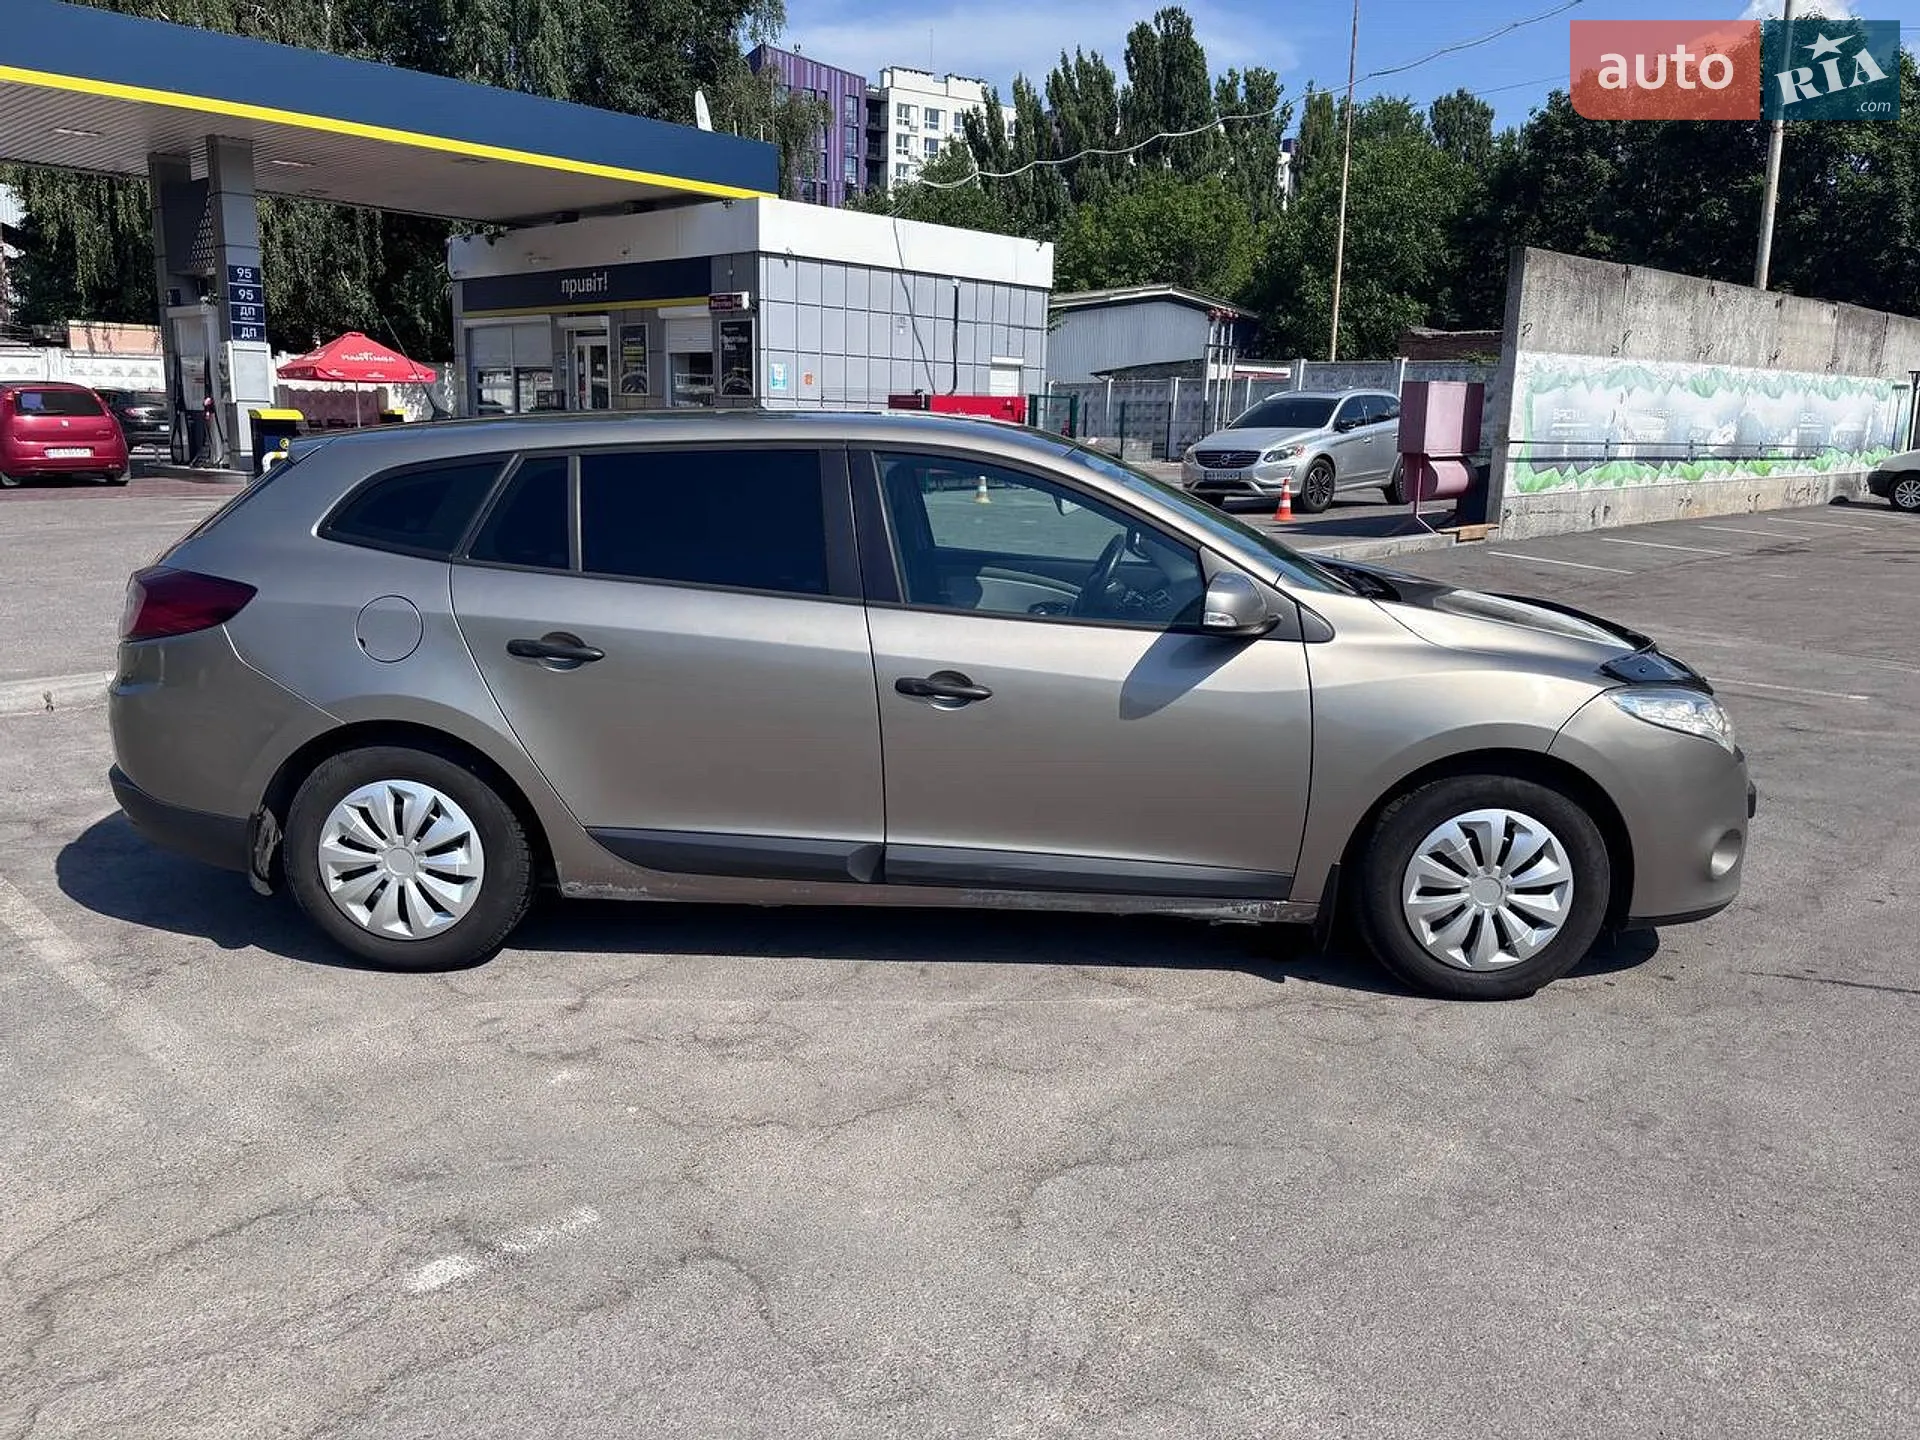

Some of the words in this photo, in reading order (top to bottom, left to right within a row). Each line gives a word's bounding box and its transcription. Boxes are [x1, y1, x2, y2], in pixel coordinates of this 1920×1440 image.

[236, 267, 252, 279] 95
[561, 271, 608, 300] привіт!
[238, 289, 254, 301] 95
[239, 306, 255, 317] ДП
[241, 327, 257, 339] ДП
